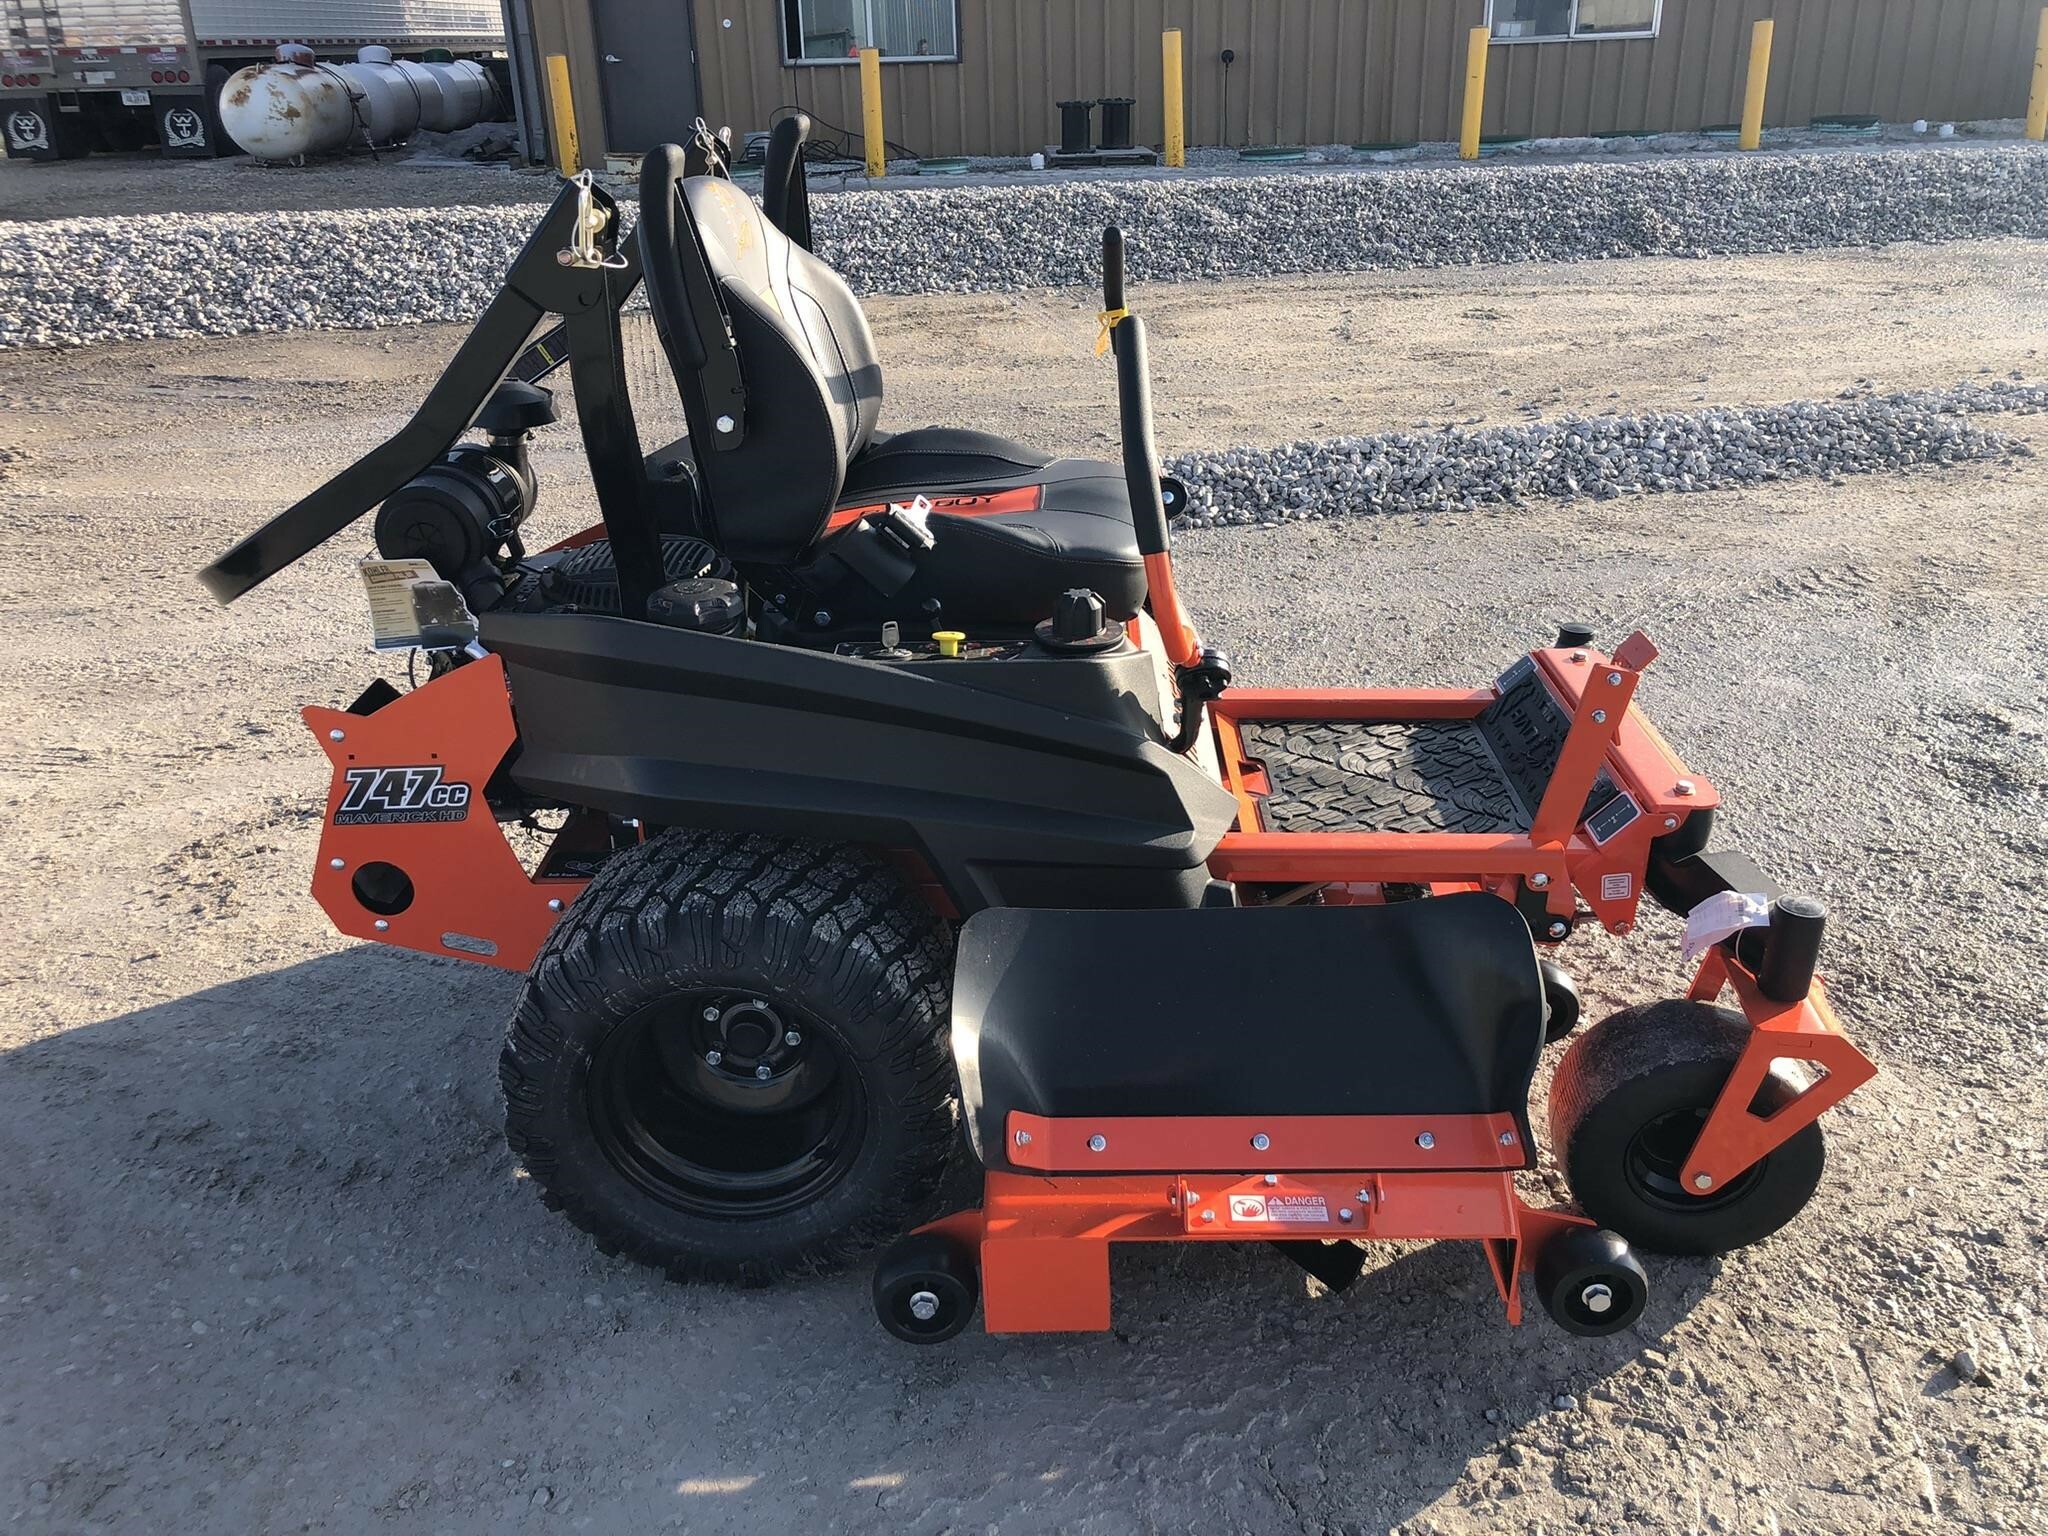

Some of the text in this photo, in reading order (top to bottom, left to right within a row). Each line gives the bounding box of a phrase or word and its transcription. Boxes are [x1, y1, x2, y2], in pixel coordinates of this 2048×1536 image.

[335, 810, 467, 824] MAVERICK HD
[1285, 1196, 1326, 1206] DANGER
